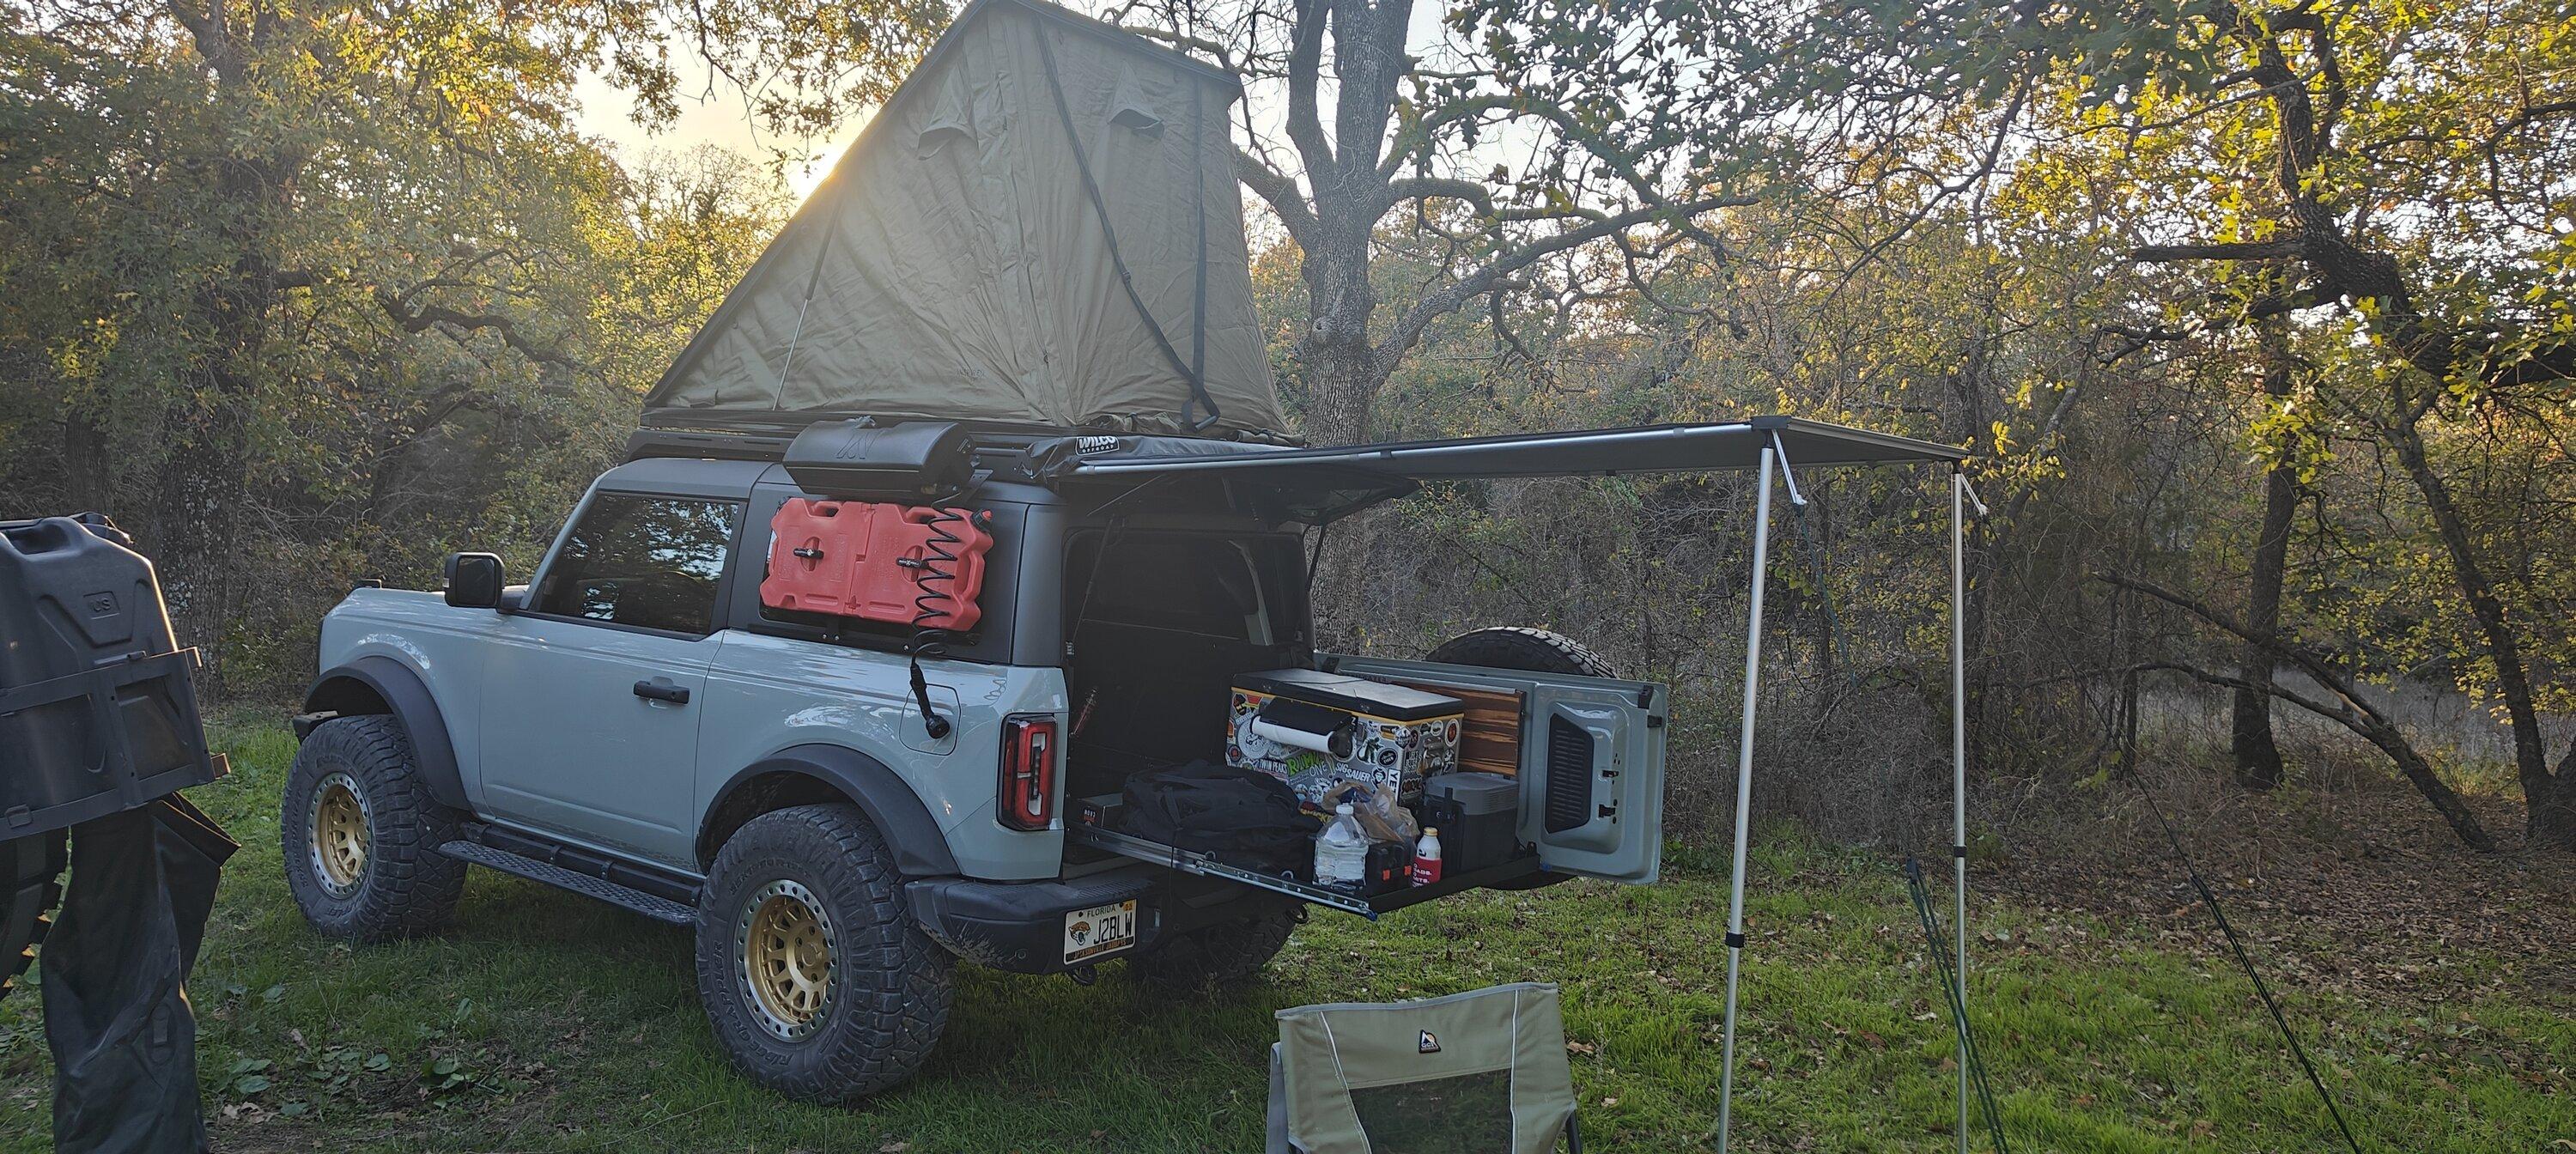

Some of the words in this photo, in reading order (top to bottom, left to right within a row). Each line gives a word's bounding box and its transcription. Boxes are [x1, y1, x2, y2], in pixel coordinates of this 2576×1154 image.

[1078, 436, 1116, 448] WILCO
[1335, 762, 1349, 773] SIG
[1346, 768, 1371, 782] SAUER
[1087, 905, 1116, 918] FLORIDA
